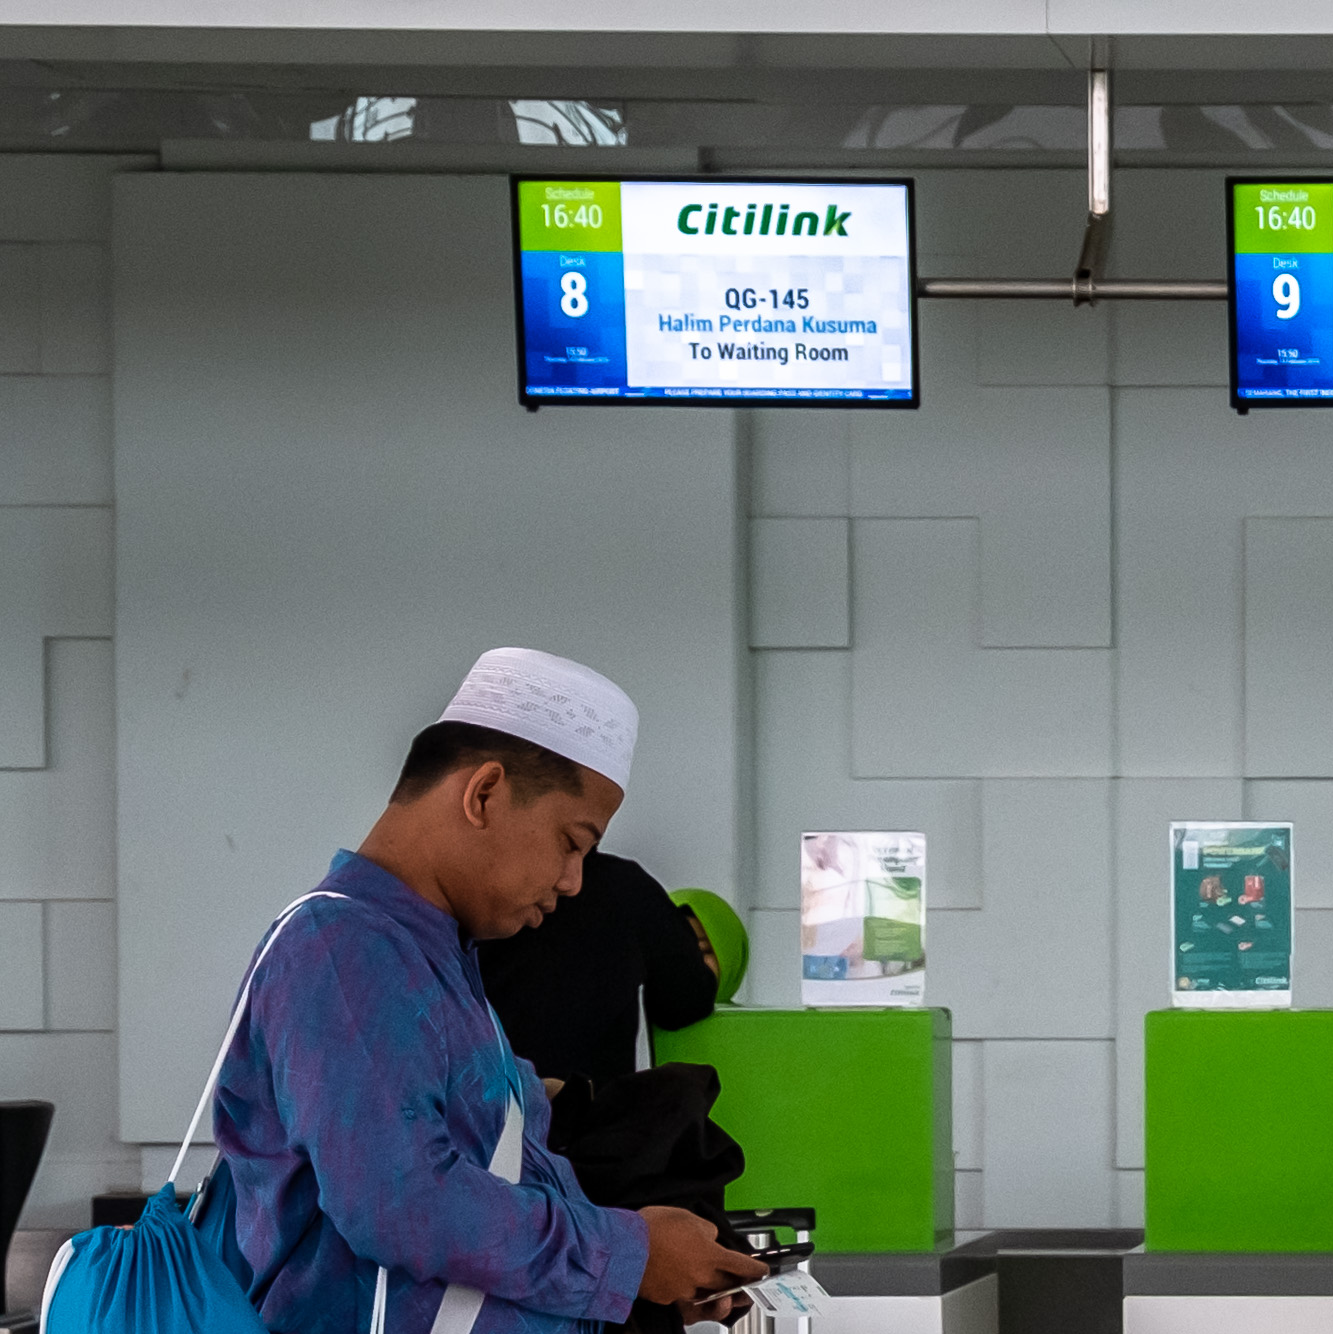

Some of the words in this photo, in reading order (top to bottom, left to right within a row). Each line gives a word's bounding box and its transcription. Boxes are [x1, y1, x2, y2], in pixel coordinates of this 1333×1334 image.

[1260, 189, 1309, 201] Schedule
[541, 204, 602, 228] 16:40
[677, 203, 852, 236] Citilink
[1255, 206, 1316, 230] 16:40
[560, 271, 589, 318] 8
[724, 289, 809, 309] QG-145
[1272, 273, 1300, 319] 9
[659, 314, 712, 332] Halim
[719, 315, 796, 333] Perdana
[802, 316, 876, 334] Kusuma
[689, 343, 711, 361] To
[718, 343, 788, 365] Waiting
[796, 344, 848, 361] Room
